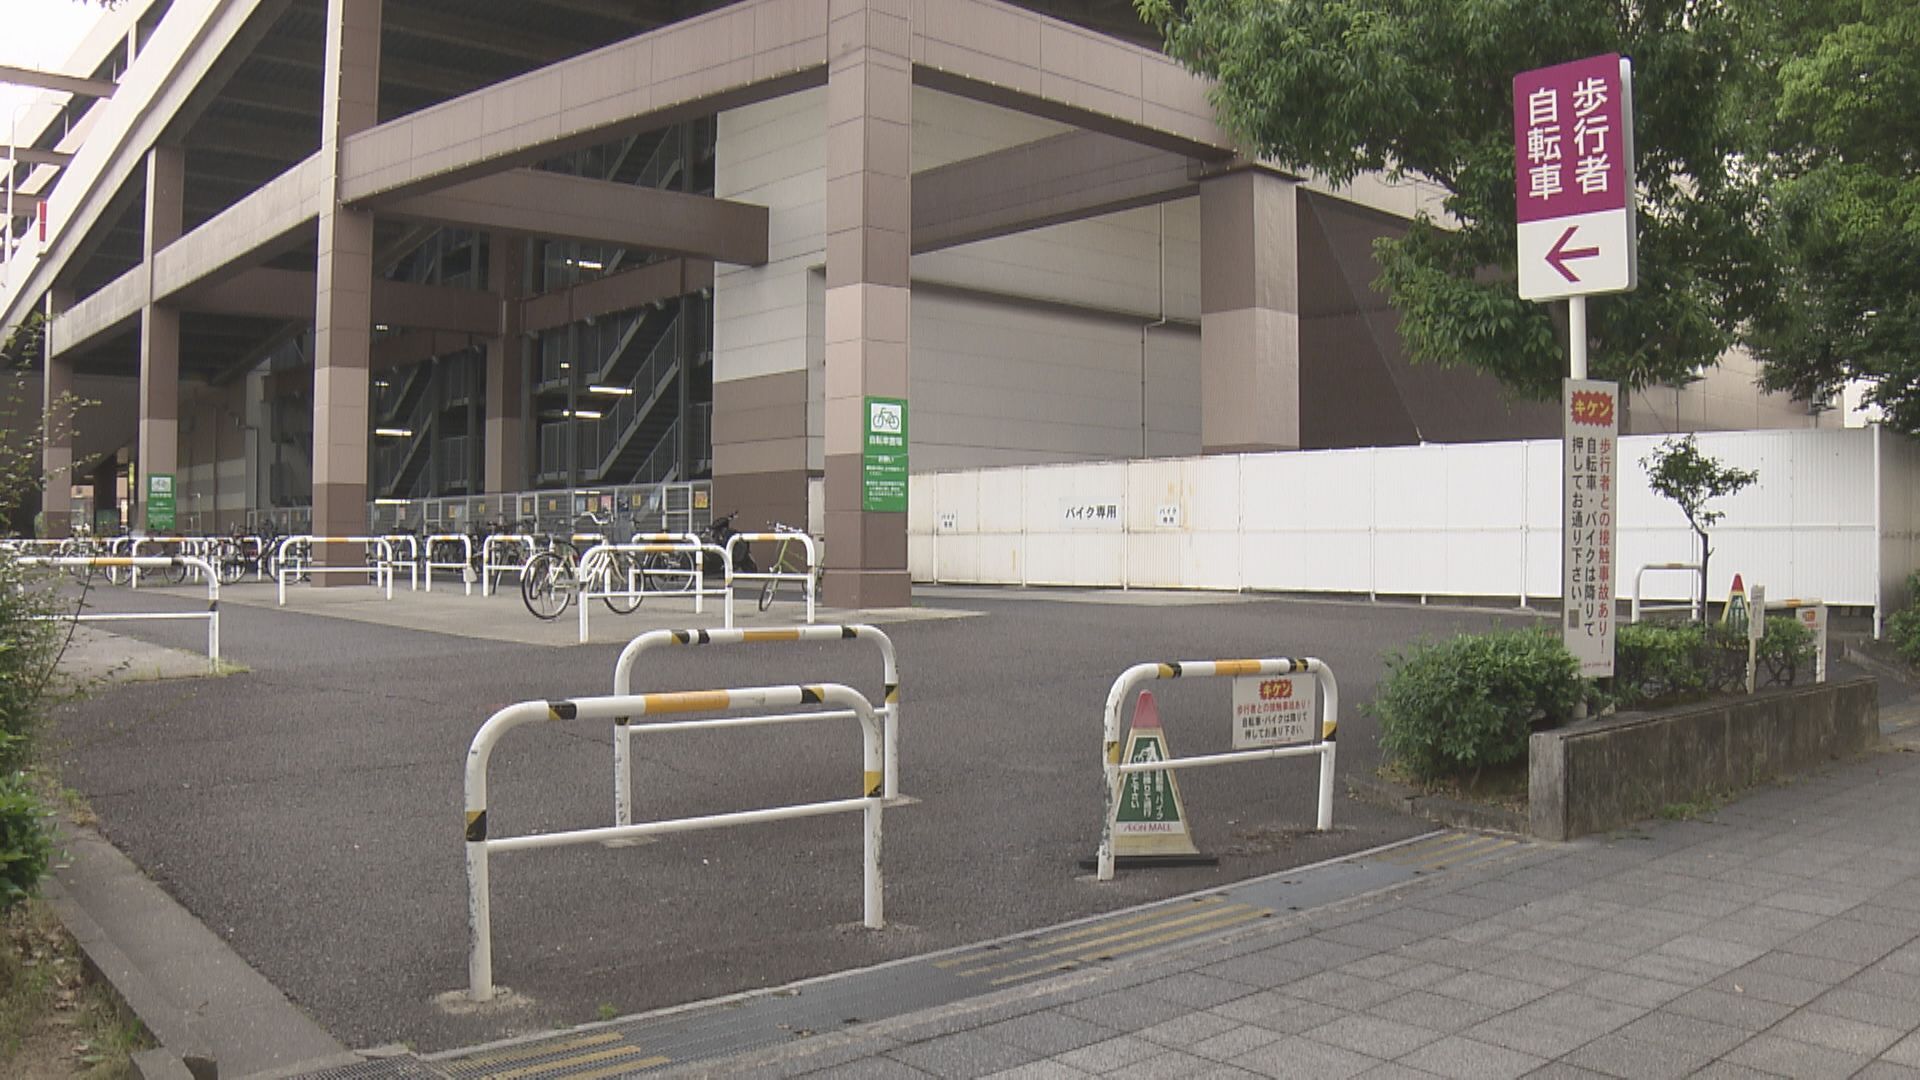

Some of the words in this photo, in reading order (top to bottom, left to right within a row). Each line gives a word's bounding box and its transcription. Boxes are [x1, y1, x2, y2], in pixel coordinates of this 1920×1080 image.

[1527, 87, 1563, 200] 自転車
[1573, 77, 1611, 195] 歩行者
[1575, 399, 1610, 418] キケン
[1065, 504, 1117, 519] バイク専用
[1262, 682, 1292, 698] キケン
[1149, 822, 1173, 833] MALL
